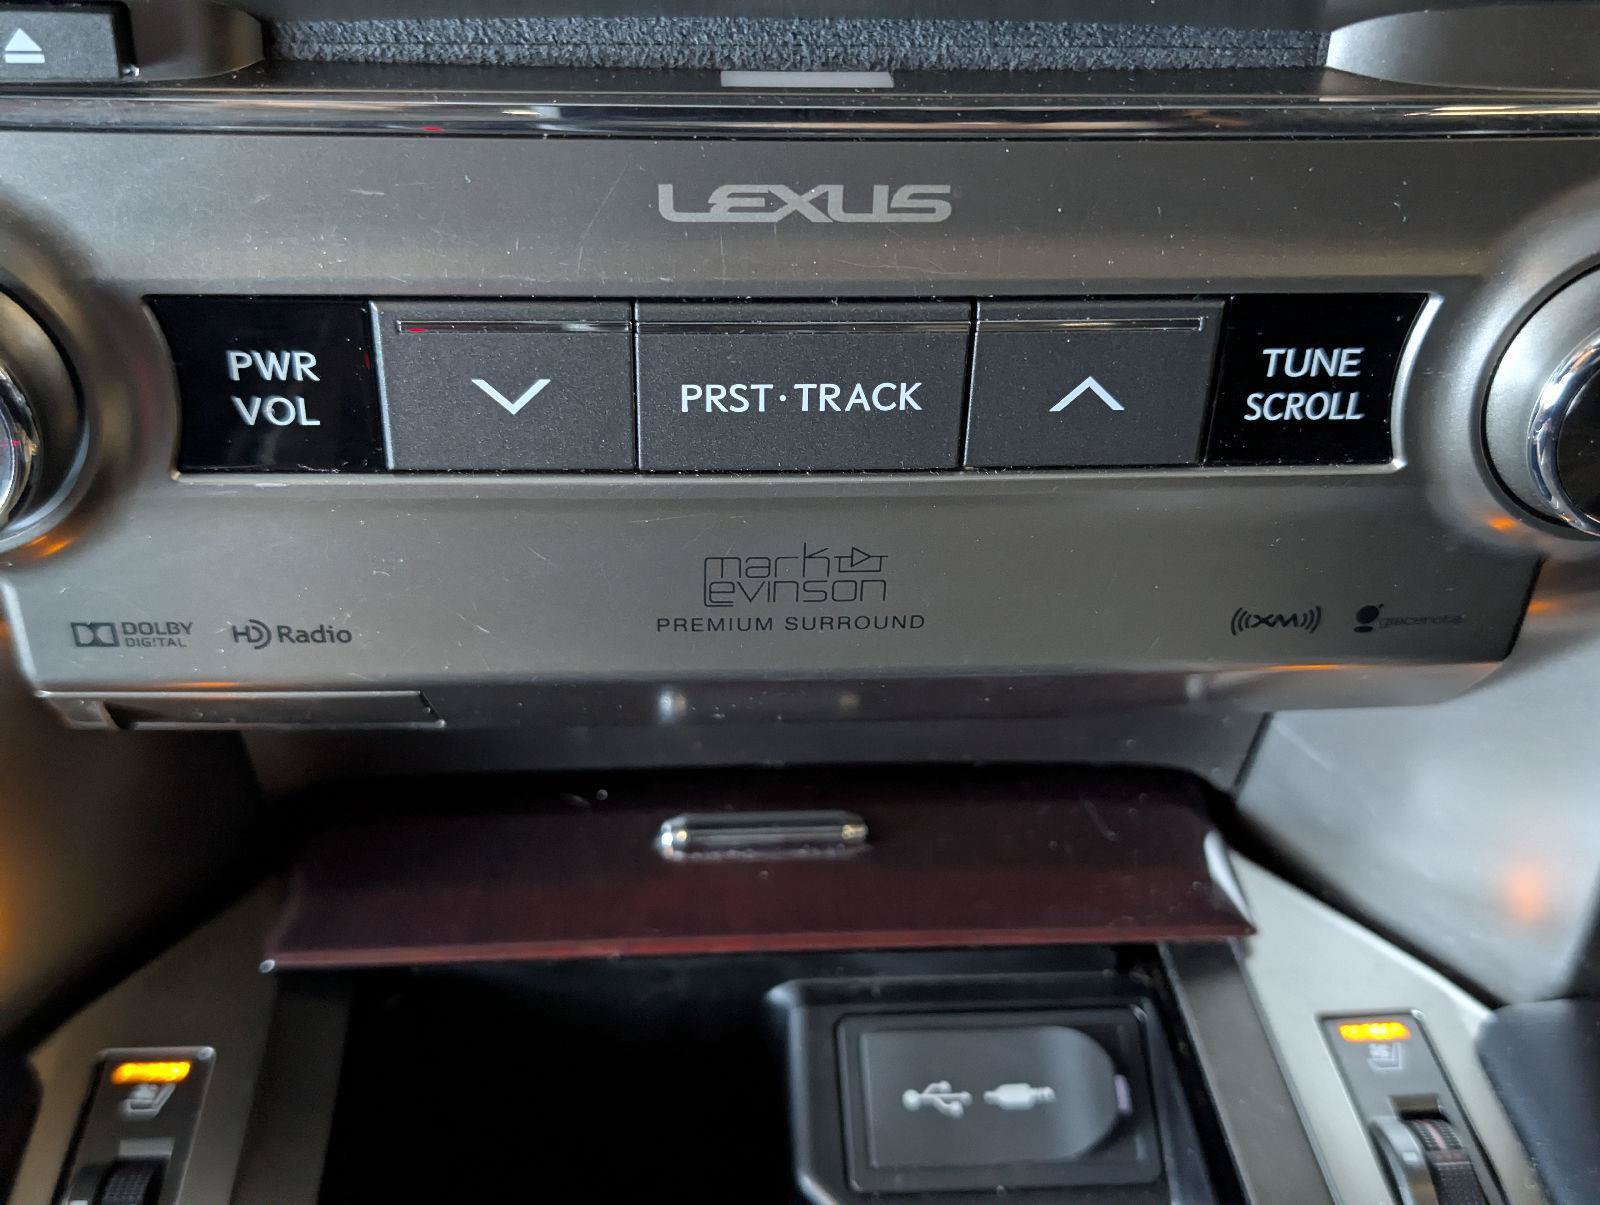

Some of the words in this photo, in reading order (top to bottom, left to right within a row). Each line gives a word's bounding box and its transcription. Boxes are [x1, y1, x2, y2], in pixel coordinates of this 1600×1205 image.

[657, 183, 952, 223] LEXUS
[226, 350, 320, 381] PWR
[1262, 347, 1365, 378] TUNE
[229, 395, 321, 426] VOL
[1243, 391, 1366, 420] SCROLL
[704, 542, 830, 579] mark
[120, 621, 193, 636] DOLBY
[276, 624, 352, 644] Radio
[656, 617, 773, 632] PREMIUM
[784, 614, 925, 631] SURROUND
[125, 637, 188, 648] DIGITAL
